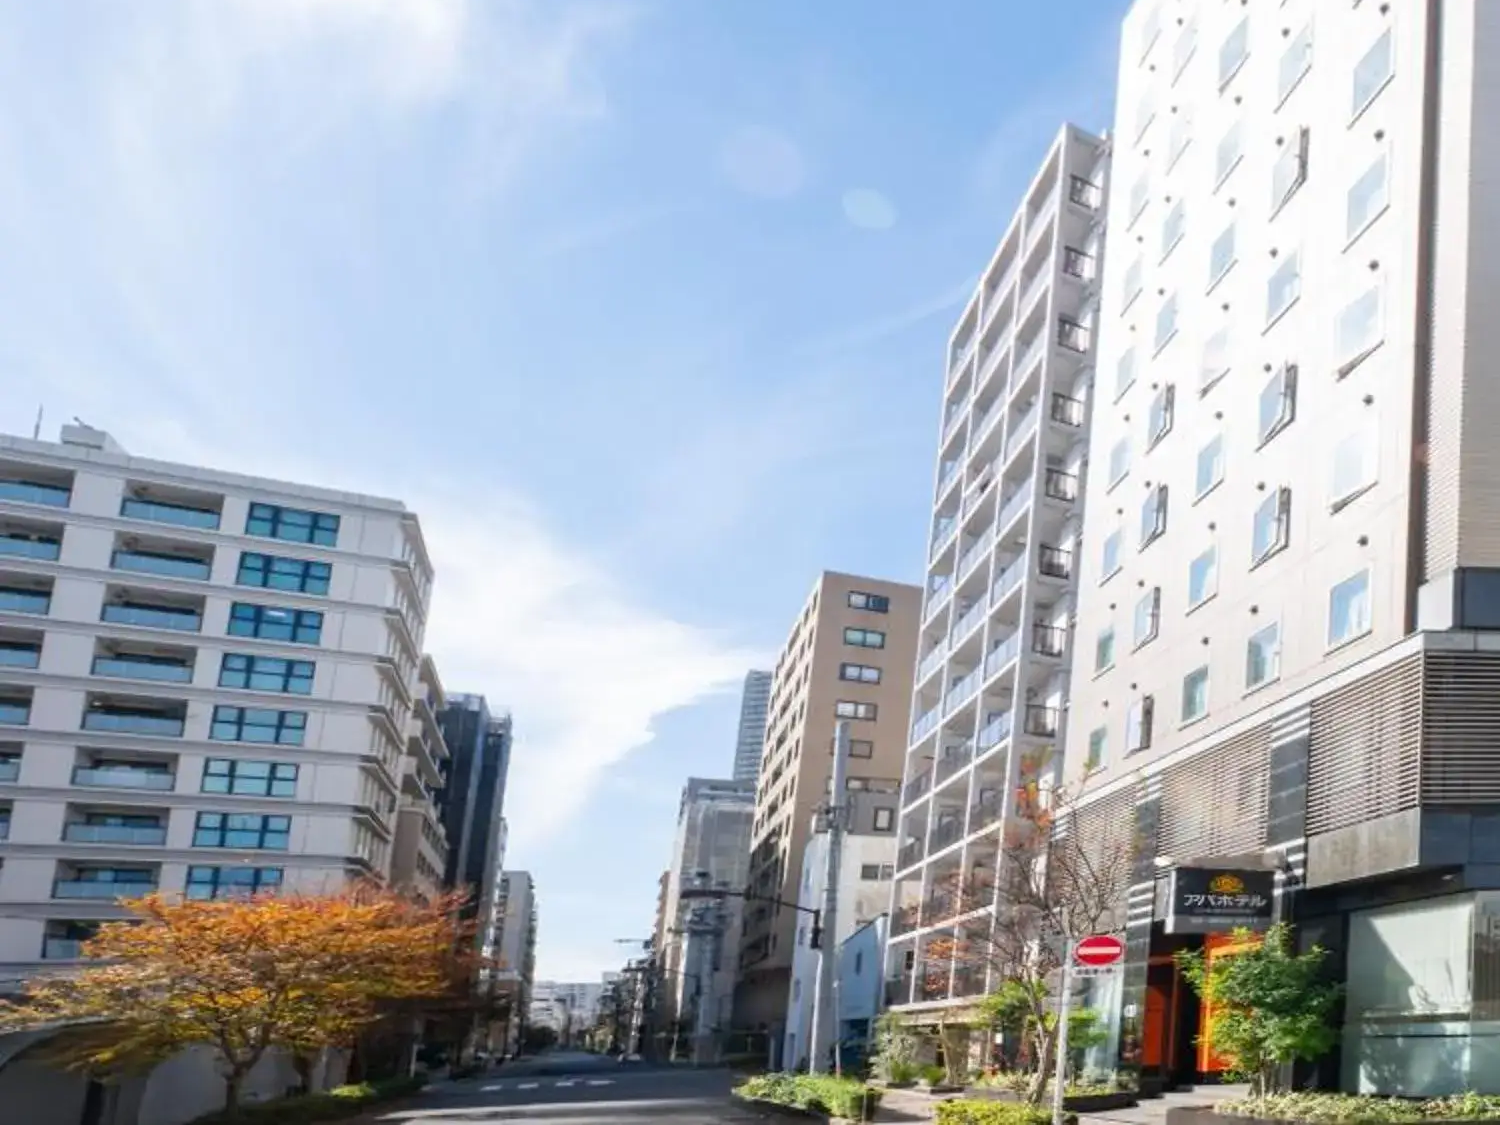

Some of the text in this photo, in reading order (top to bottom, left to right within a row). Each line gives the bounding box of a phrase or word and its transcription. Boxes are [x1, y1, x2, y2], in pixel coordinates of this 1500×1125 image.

[1183, 894, 1268, 907] アパホテル
